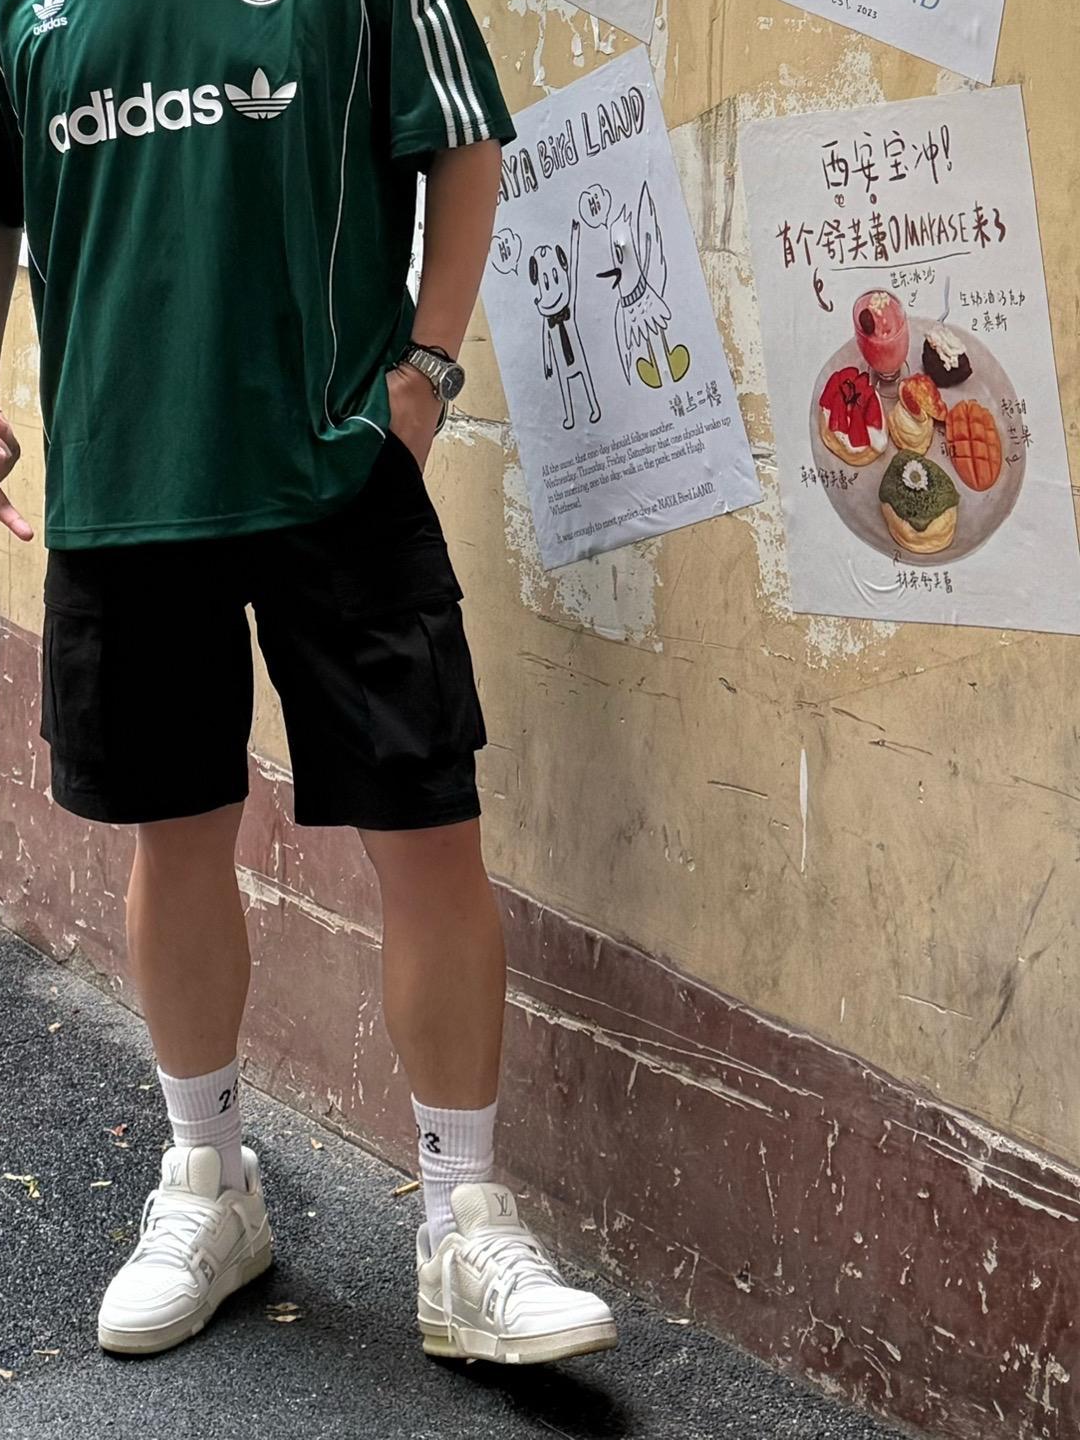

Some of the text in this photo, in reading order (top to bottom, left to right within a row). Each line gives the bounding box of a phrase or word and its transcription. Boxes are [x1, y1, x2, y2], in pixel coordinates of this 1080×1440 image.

[33, 16, 68, 35] adidas
[857, 4, 878, 20] 2023
[49, 81, 223, 153] adidas
[497, 86, 645, 204] YA Bird LAND
[588, 193, 601, 217] Hi
[498, 238, 511, 263] Hi
[669, 380, 722, 418] 请上二楼
[682, 424, 703, 438] should
[722, 417, 731, 426] up
[599, 444, 609, 454] day
[630, 429, 647, 441] follow
[644, 457, 653, 468] the
[686, 439, 704, 455] Hugh
[573, 522, 594, 539] enough
[595, 522, 601, 530] to
[658, 494, 677, 509] NAYA
[416, 1124, 441, 1154] 3
